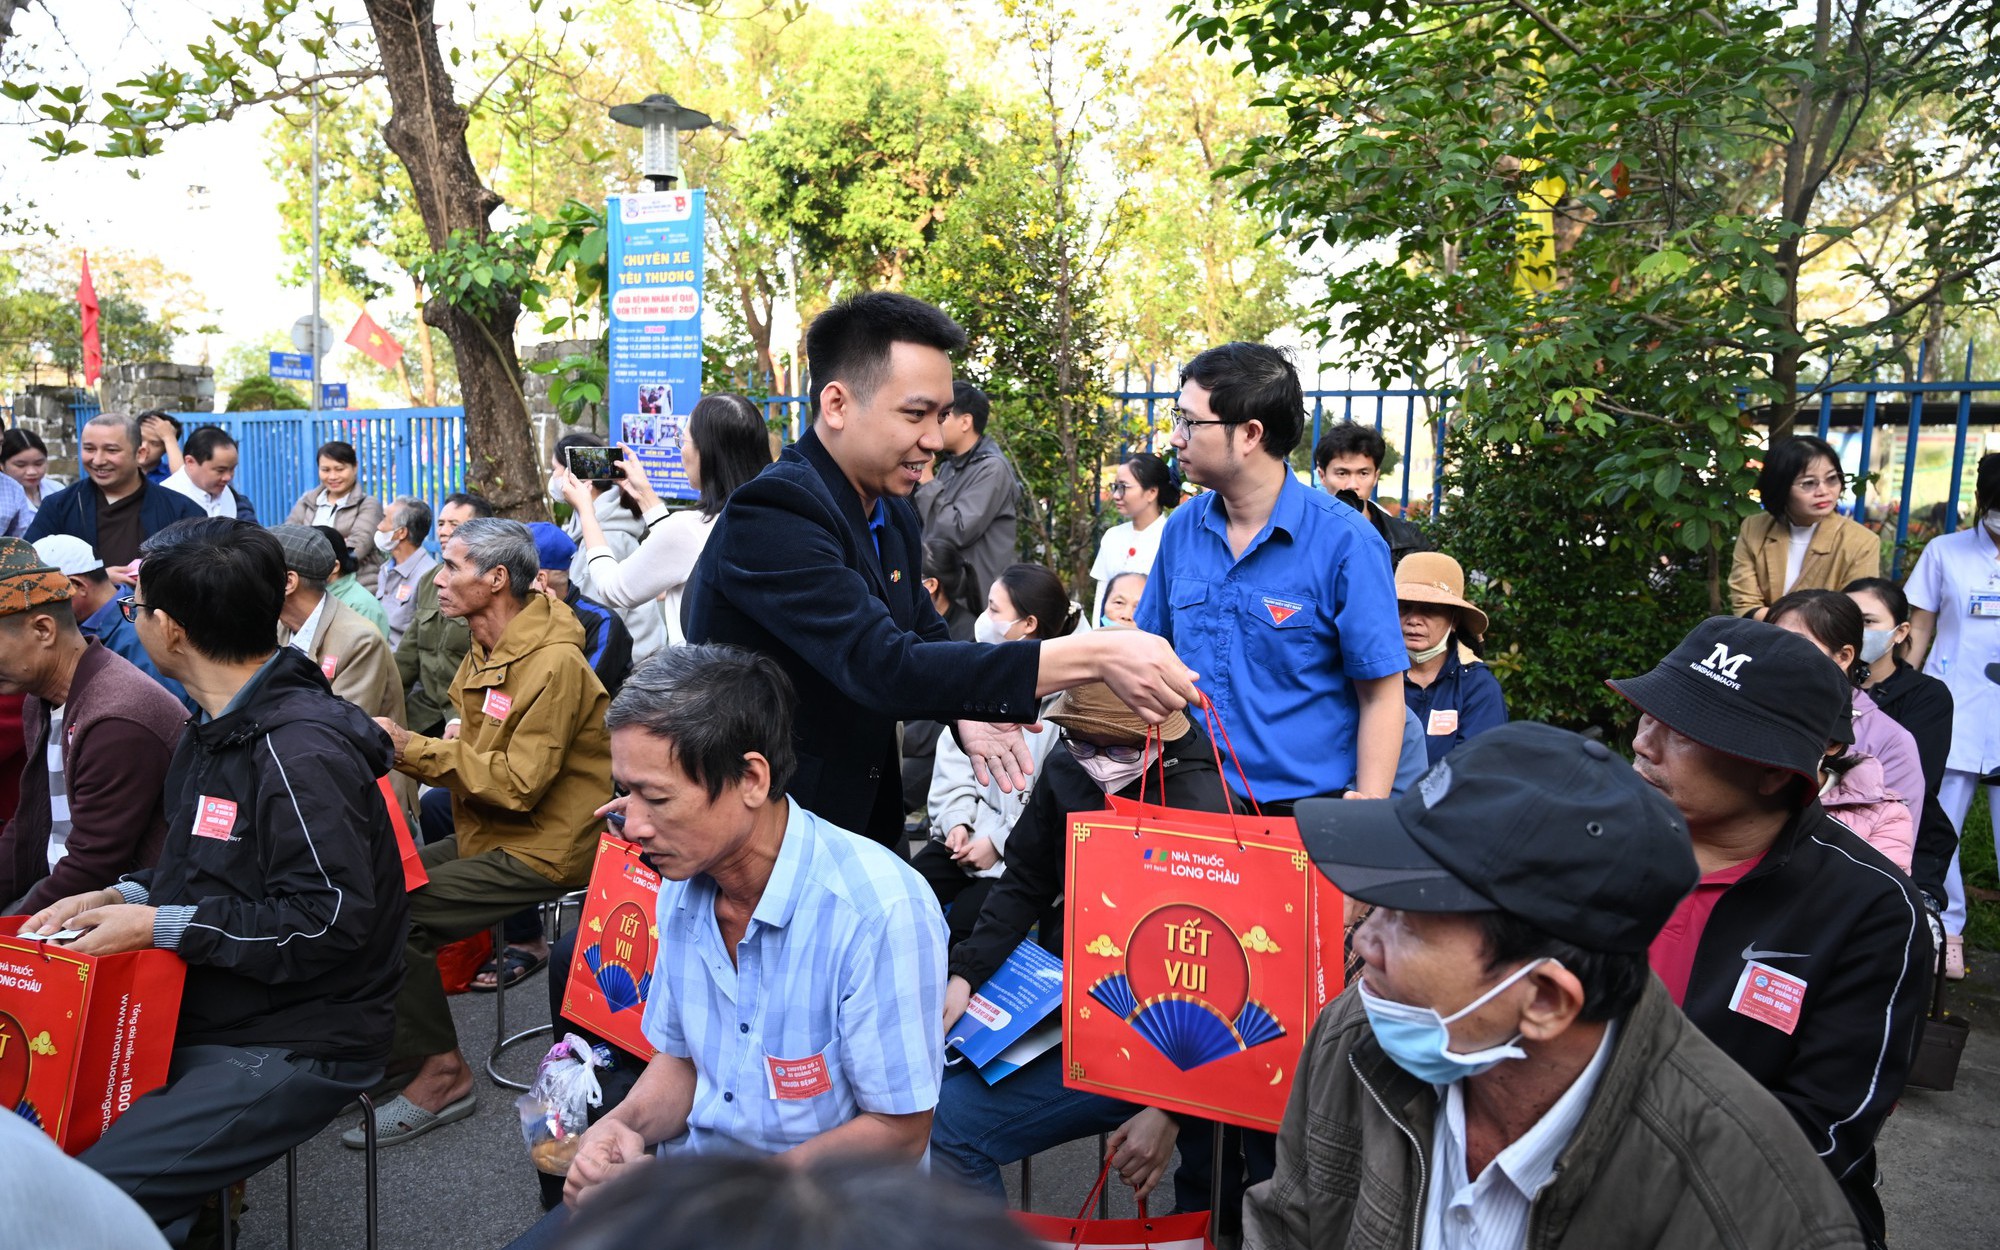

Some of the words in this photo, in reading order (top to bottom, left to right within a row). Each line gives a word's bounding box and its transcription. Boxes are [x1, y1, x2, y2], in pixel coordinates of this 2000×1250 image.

[673, 251, 690, 264] XE
[618, 271, 642, 285] YÊU
[1700, 642, 1752, 680] M
[1171, 850, 1190, 862] NHÀ
[1192, 853, 1224, 868] THUỐC
[632, 875, 647, 888] LONG
[1171, 863, 1204, 879] LONG
[1206, 868, 1240, 885] CHÂU
[619, 913, 640, 938] TẾT
[1164, 917, 1213, 957] TẾT
[615, 937, 633, 962] VUI
[10, 964, 34, 977] THUỐC
[1164, 958, 1208, 992] VUI
[17, 978, 42, 992] CHÂU
[1317, 966, 1326, 1004] 1800
[129, 1002, 142, 1025] Tổng
[128, 1025, 138, 1039] đài
[124, 1040, 136, 1061] miễn
[117, 1077, 133, 1112] 1800
